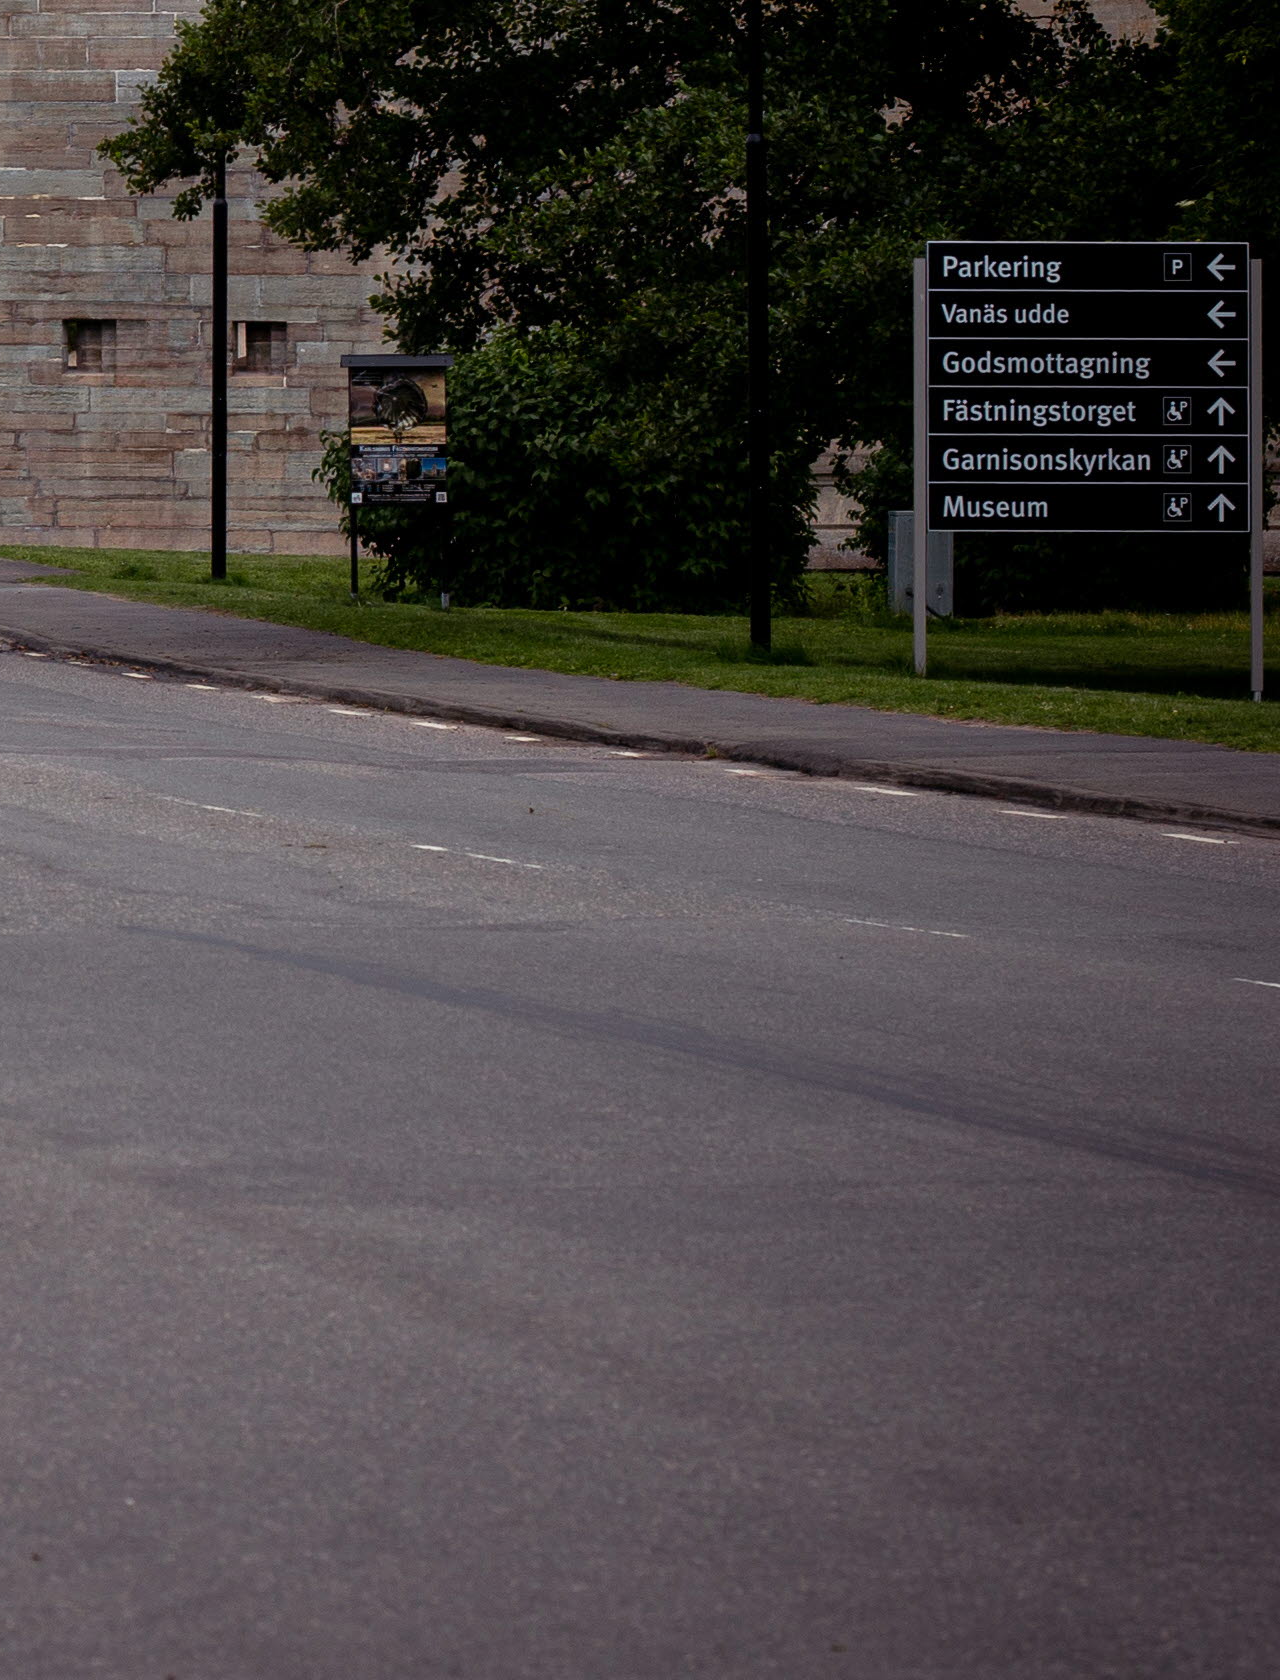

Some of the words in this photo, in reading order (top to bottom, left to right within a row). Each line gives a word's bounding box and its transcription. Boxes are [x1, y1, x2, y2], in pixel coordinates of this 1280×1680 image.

[943, 254, 1063, 284] Parkering
[941, 303, 1008, 324] Vanäs
[1014, 302, 1070, 324] udde
[942, 350, 1152, 380] Godsmottagning
[943, 398, 1137, 427] Fästningstorget
[942, 447, 1151, 477] Garnisonskyrkan
[943, 495, 1048, 518] Museum
